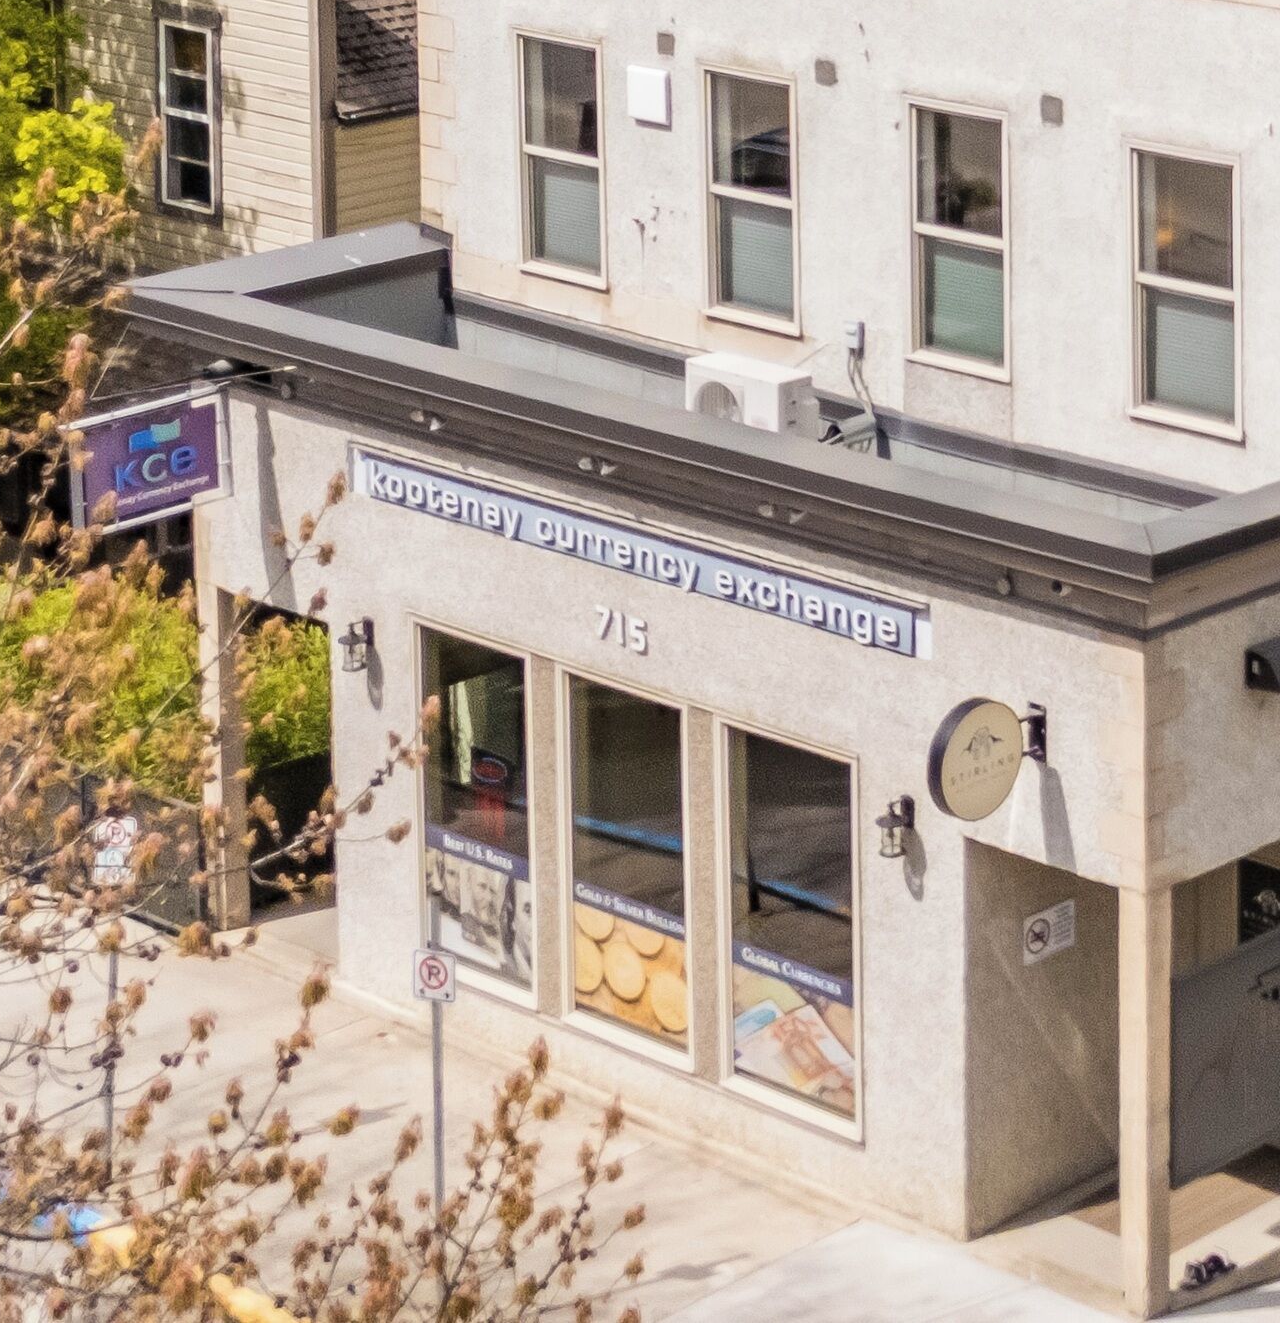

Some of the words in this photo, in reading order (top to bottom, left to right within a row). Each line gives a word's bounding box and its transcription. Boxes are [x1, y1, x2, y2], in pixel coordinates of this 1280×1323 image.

[370, 461, 520, 539] kootenay
[535, 517, 697, 592] currency
[714, 569, 898, 644] exchange
[595, 605, 647, 652] 715
